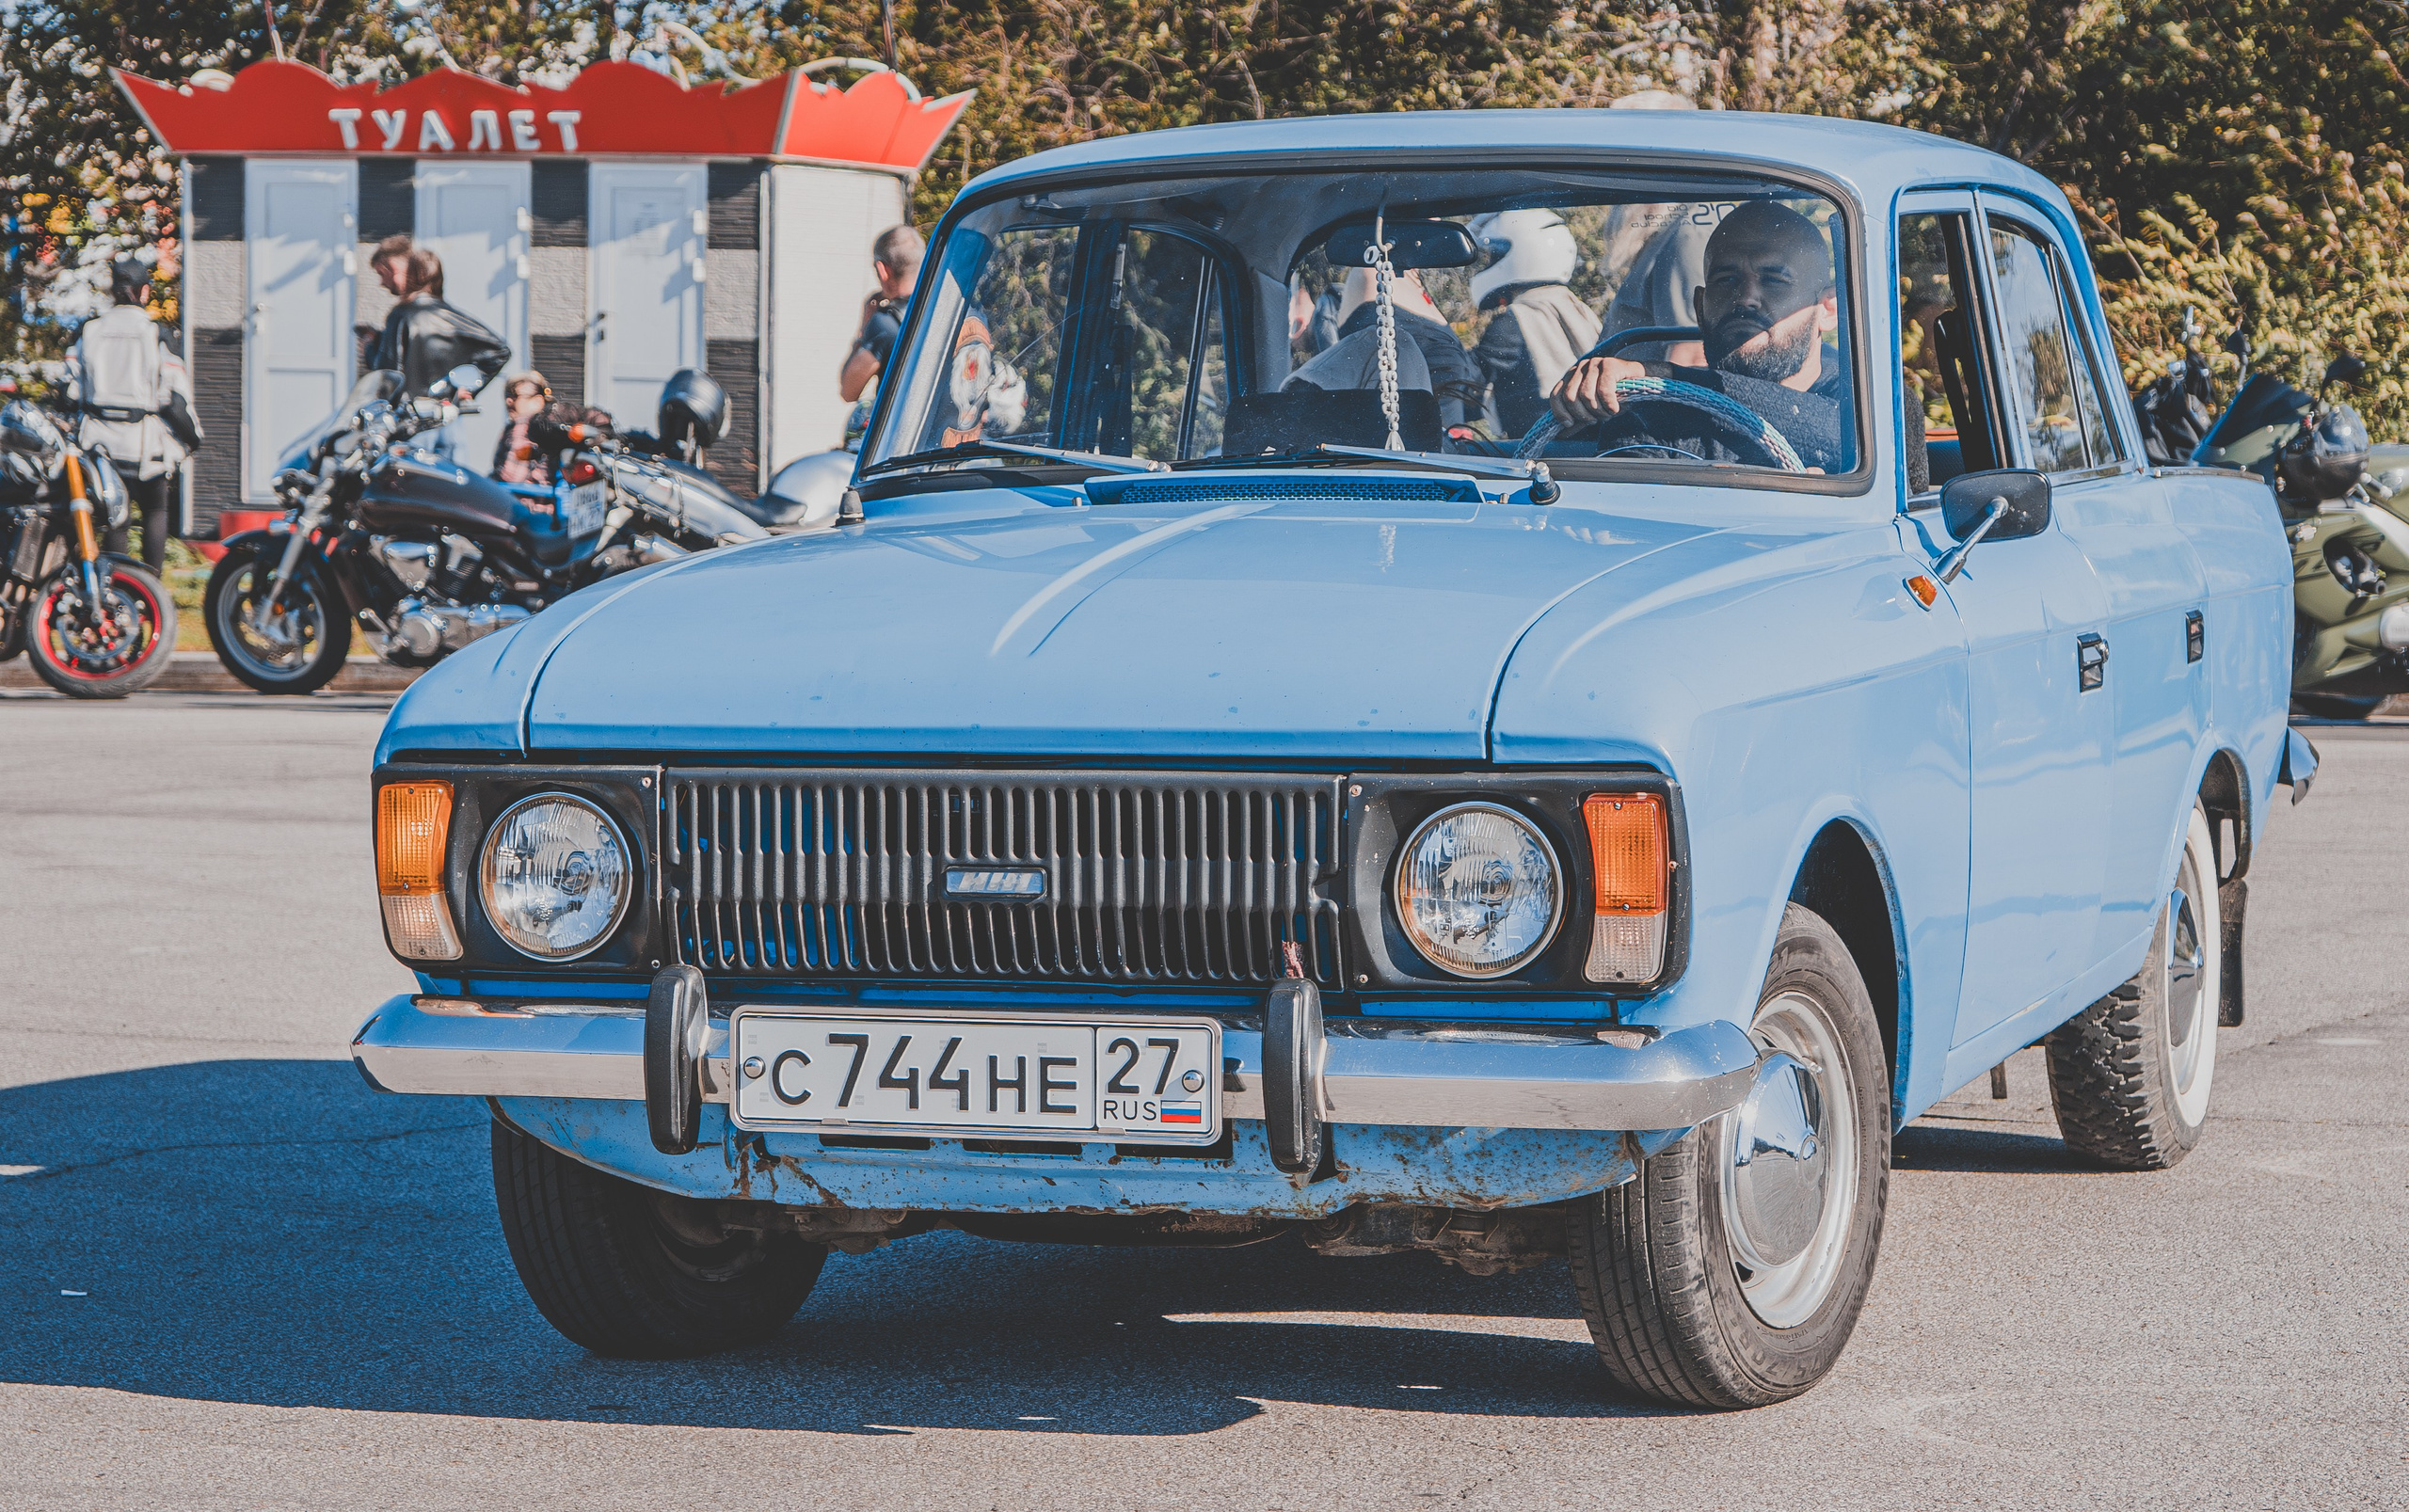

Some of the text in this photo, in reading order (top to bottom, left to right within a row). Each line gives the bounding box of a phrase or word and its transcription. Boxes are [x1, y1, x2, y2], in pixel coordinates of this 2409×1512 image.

[329, 108, 582, 151] ТУАЛЕТ
[1106, 1037, 1179, 1095] 27
[1104, 1099, 1157, 1121] RUS
